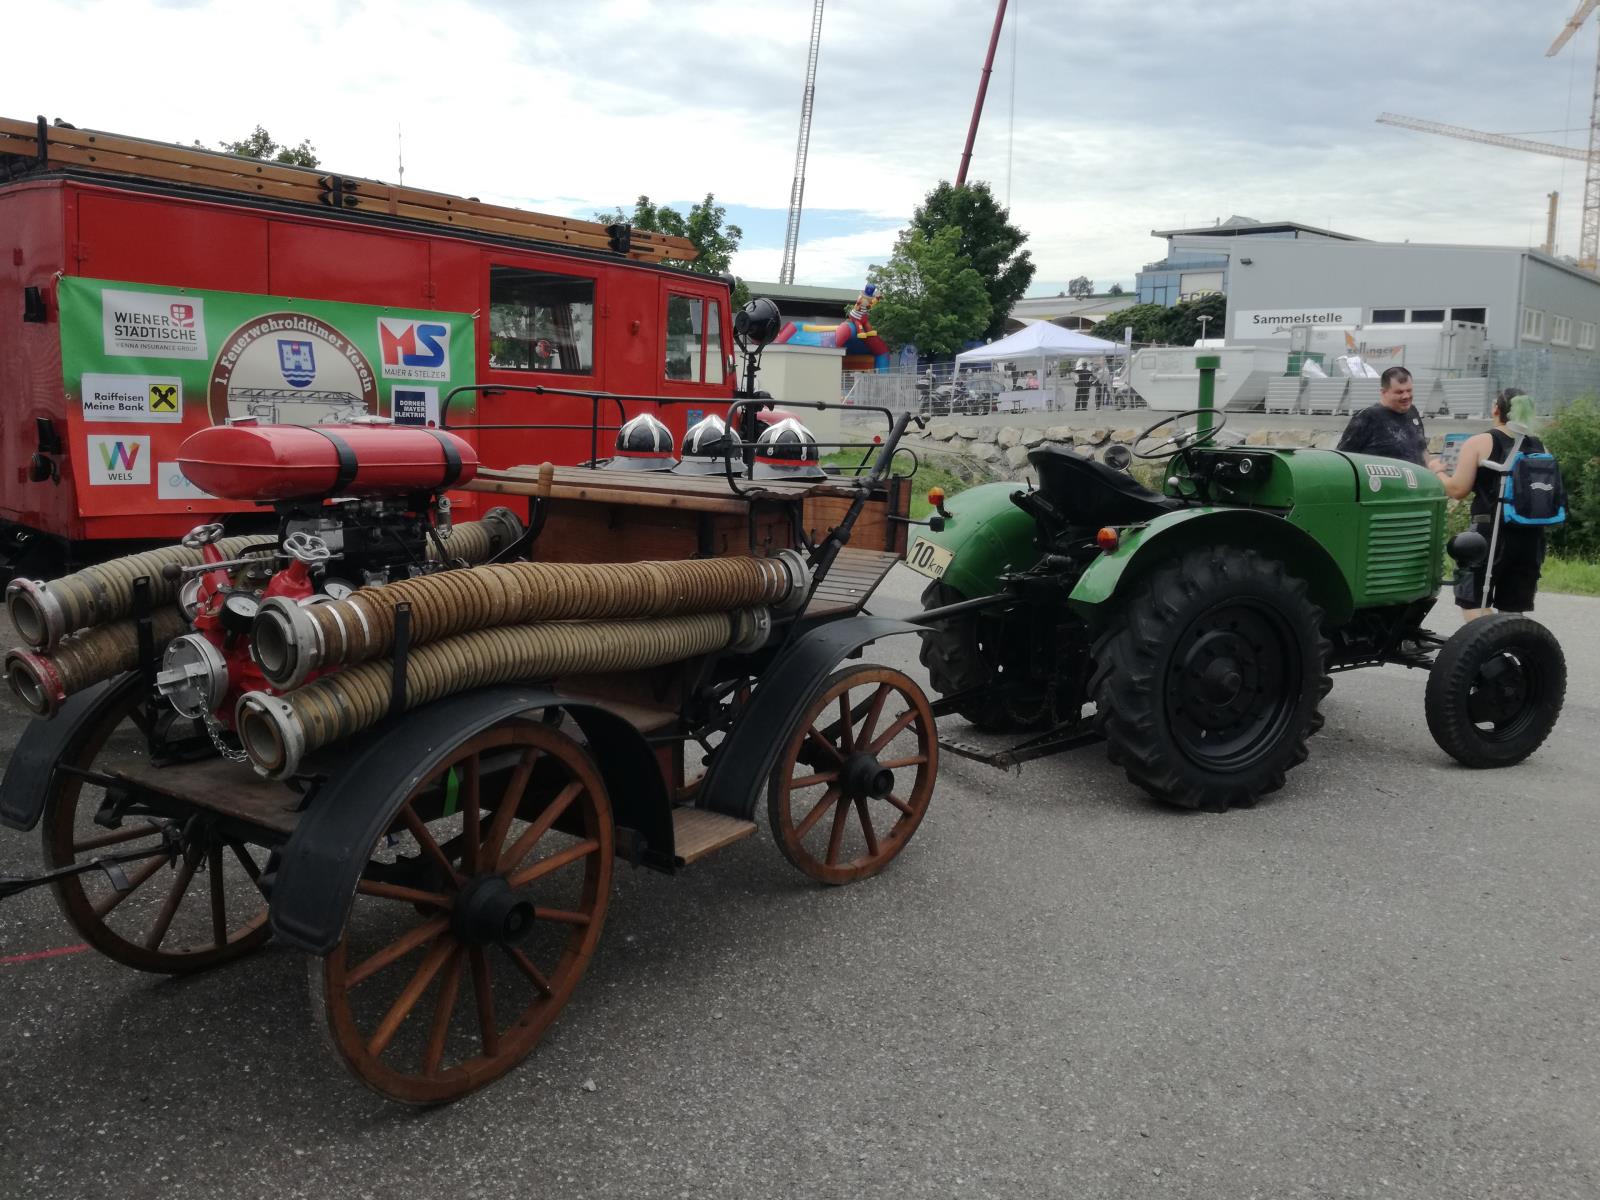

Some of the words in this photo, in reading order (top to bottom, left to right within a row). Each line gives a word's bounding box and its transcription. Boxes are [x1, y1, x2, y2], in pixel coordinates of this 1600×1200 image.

[114, 311, 170, 327] WIENER
[1252, 312, 1343, 325] Sammelstelle
[114, 325, 198, 341] STÄDTISCHE
[140, 343, 176, 351] INSURANCE
[177, 344, 198, 352] GROUP
[380, 321, 447, 368] MS
[221, 316, 345, 371] Feuerwehroldtimer
[346, 345, 373, 393] Verein
[384, 368, 407, 377] MAIER
[408, 369, 413, 377] &
[414, 370, 446, 379] STELZER
[94, 392, 144, 402] Raiffeisen
[84, 402, 115, 411] Meine
[118, 403, 144, 411] Bank
[108, 472, 133, 481] WELS
[911, 541, 935, 568] 10
[927, 557, 944, 576] km
